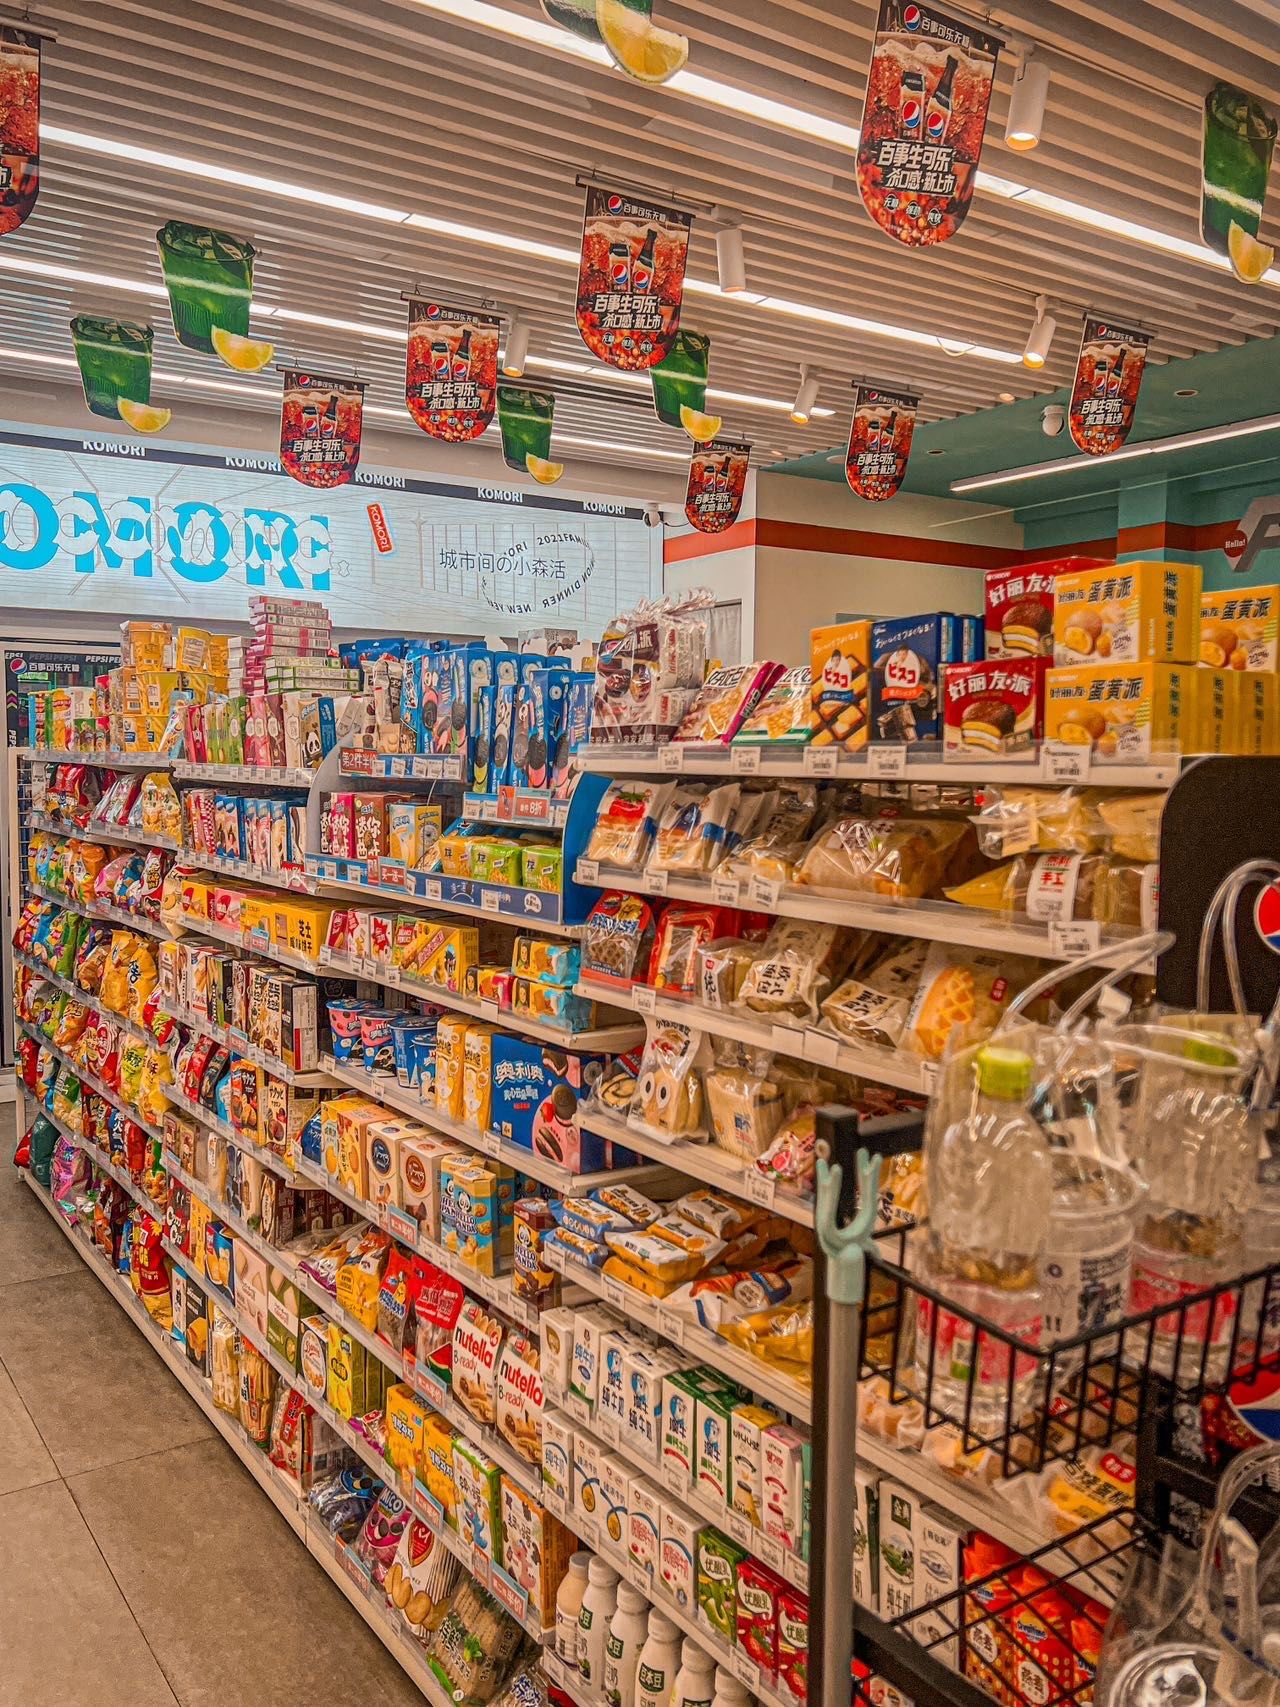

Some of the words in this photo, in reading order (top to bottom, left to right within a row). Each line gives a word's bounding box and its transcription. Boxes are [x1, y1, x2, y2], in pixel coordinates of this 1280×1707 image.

[921, 17, 970, 49] 百事可乐无糖
[878, 142, 953, 172] 百事生可乐
[594, 295, 659, 314] 百事生可乐
[421, 383, 477, 398] 百事生可乐
[82, 440, 147, 457] KOMORI
[225, 456, 281, 473] KOMORI
[354, 472, 406, 488] KOMORI
[477, 486, 524, 503] KOMORI
[583, 501, 626, 516] KOMORI
[370, 506, 390, 550] KOMORI
[1225, 538, 1246, 549] Hello!
[439, 547, 566, 580] 城市间の小森活
[1087, 576, 1134, 605] 蛋黄派
[1221, 597, 1272, 621] 蛋黄派
[86, 655, 107, 663] PEPSI
[824, 669, 849, 689] ビスコ
[888, 663, 917, 684] ビスコ
[1088, 677, 1144, 702] 蛋黄派
[454, 1326, 495, 1369] nutella
[500, 1360, 544, 1408] nutella
[704, 1557, 730, 1579] 优酸乳
[743, 1591, 770, 1612] 优酸乳
[640, 1665, 665, 1688] 豆本豆
